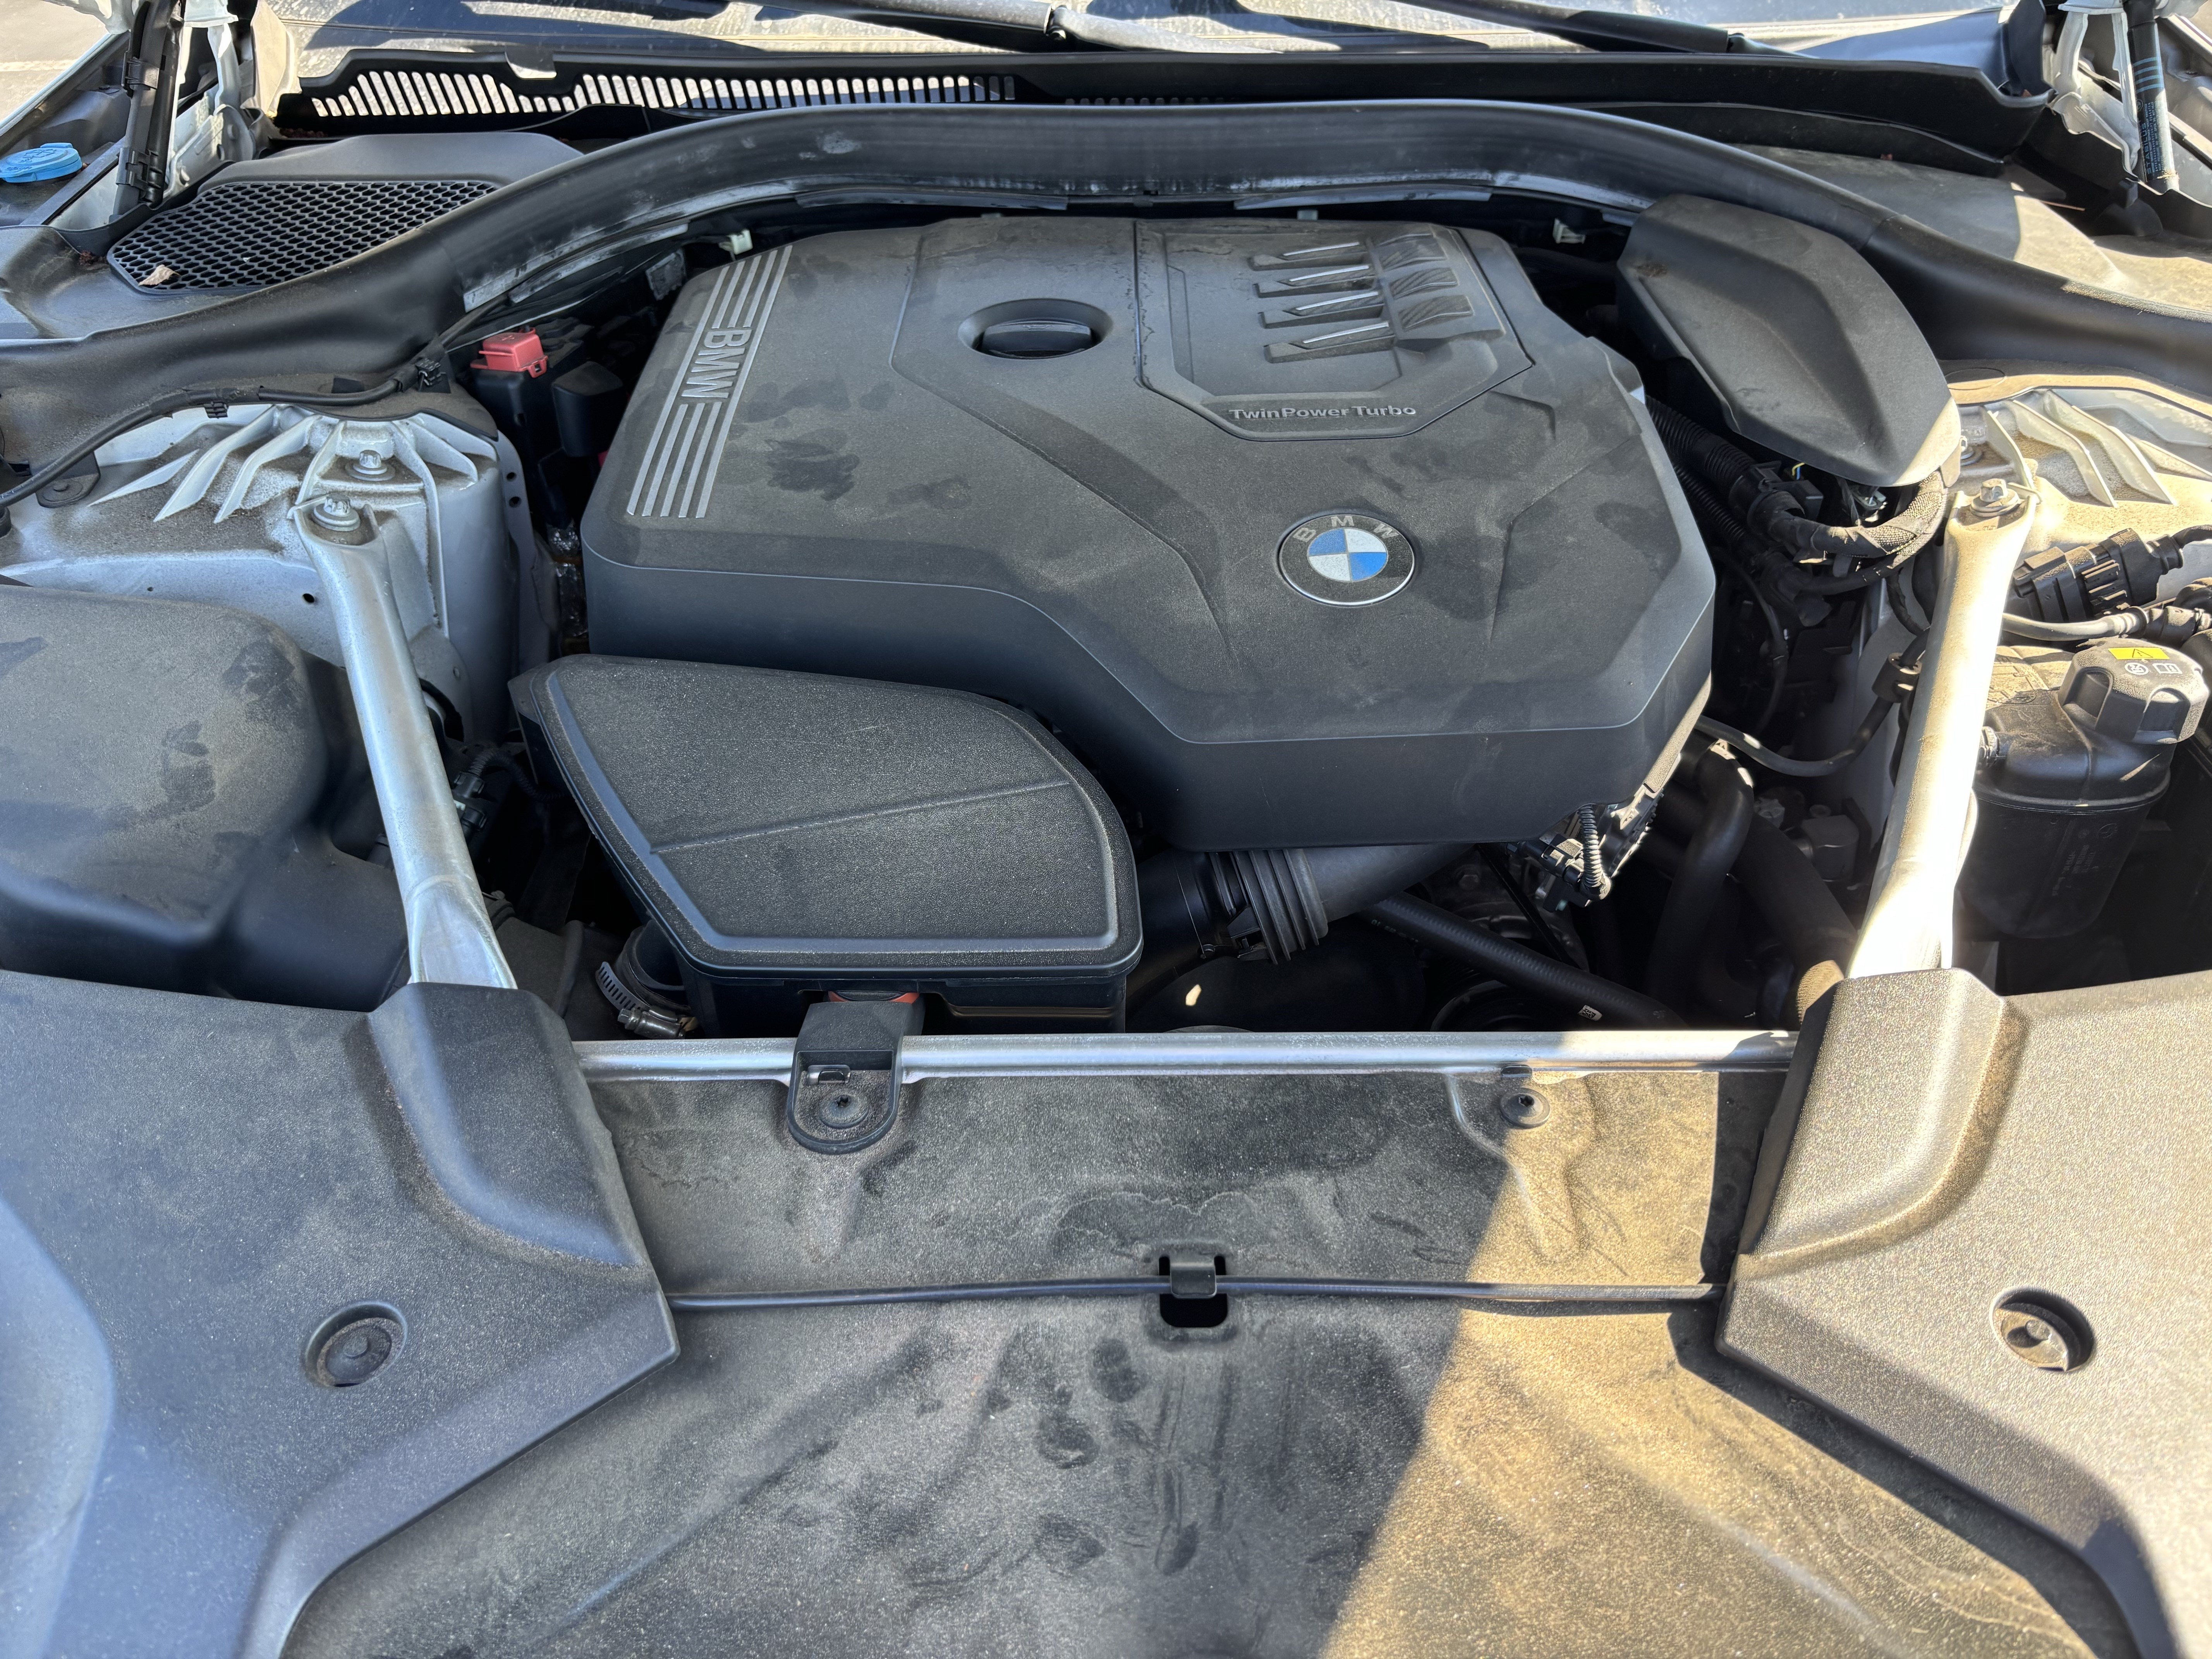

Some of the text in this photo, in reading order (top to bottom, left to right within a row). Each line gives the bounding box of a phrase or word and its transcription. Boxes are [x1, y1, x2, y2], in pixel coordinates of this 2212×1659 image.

[2140, 122, 2152, 174] STABILUS
[681, 329, 752, 398] BMW
[1352, 405, 1416, 416] Turbo
